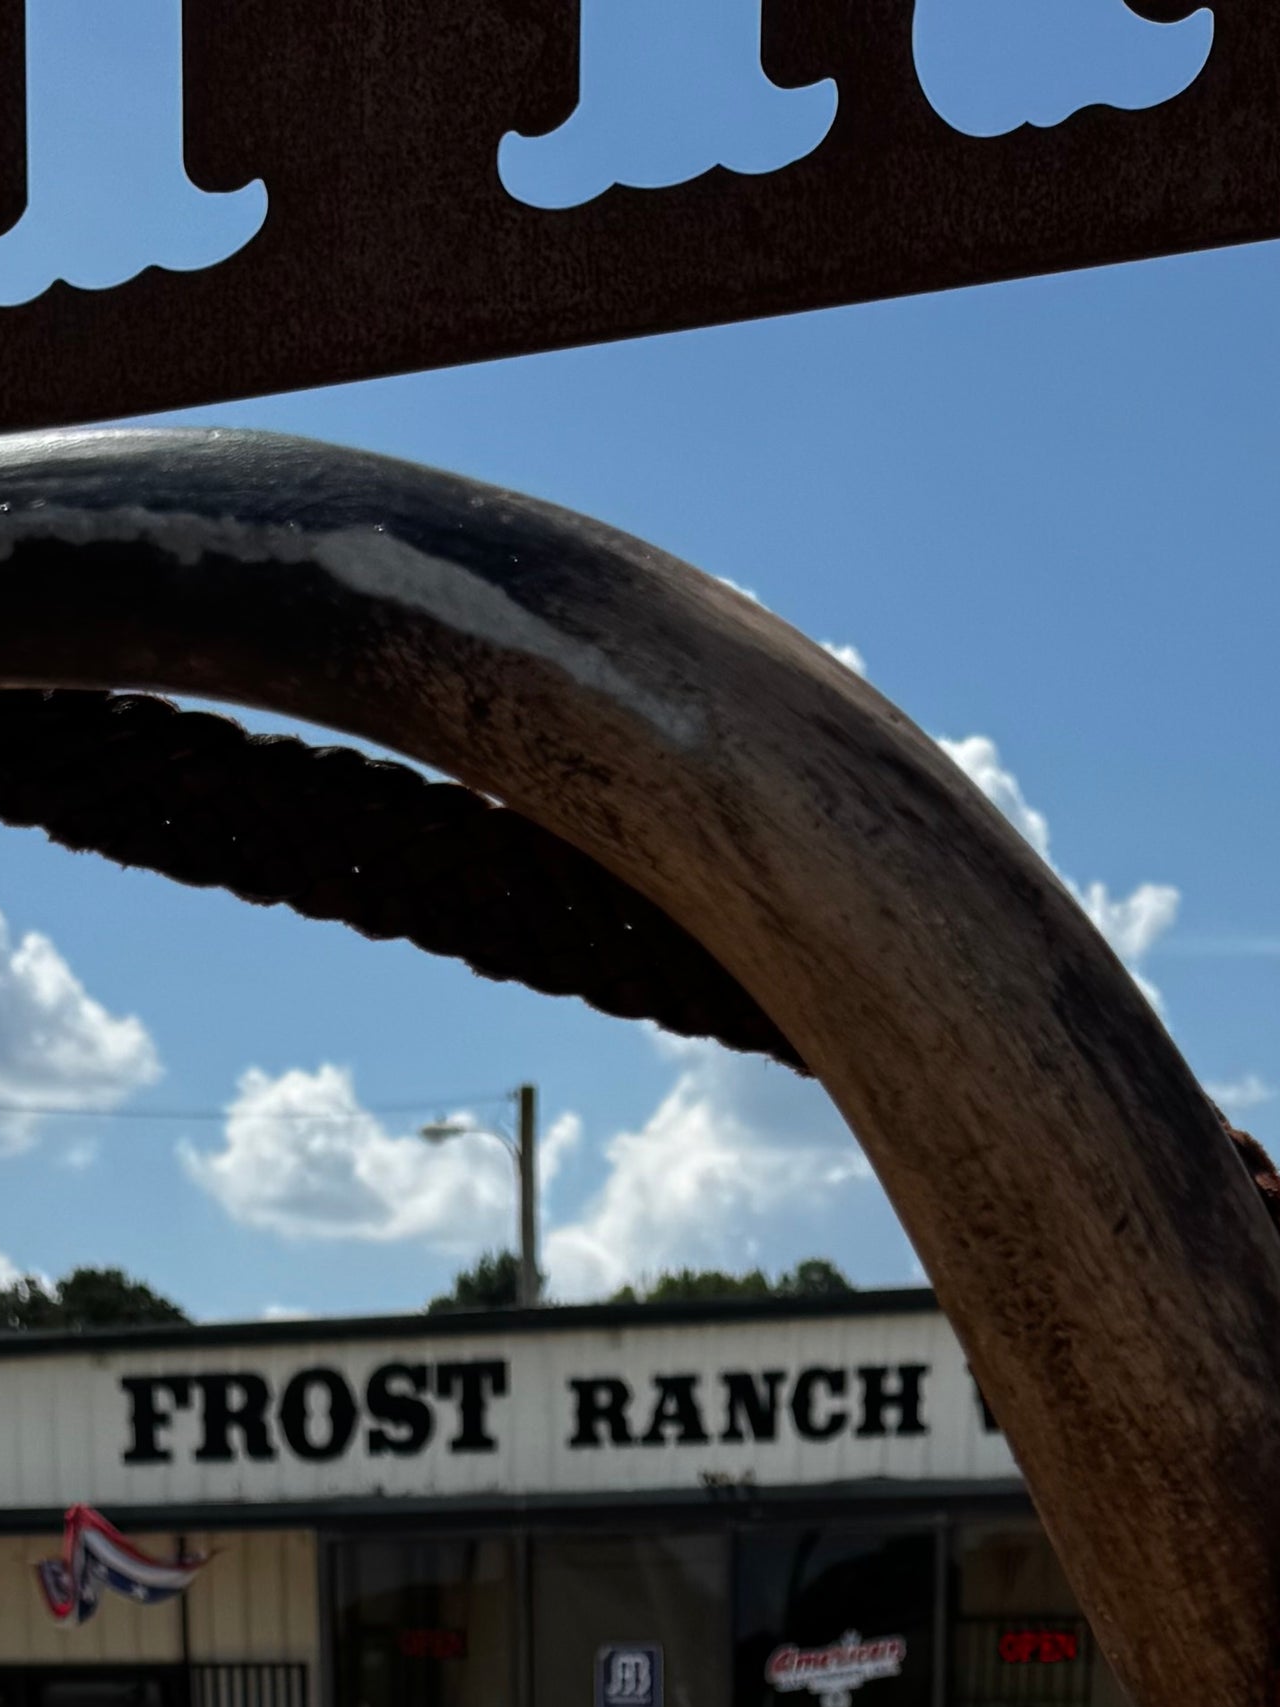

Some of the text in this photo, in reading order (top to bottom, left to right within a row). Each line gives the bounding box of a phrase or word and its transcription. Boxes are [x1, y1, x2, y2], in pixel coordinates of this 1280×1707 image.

[120, 1358, 508, 1466] FROST
[566, 1363, 931, 1449] RANCH
[998, 1632, 1077, 1663] OPEN
